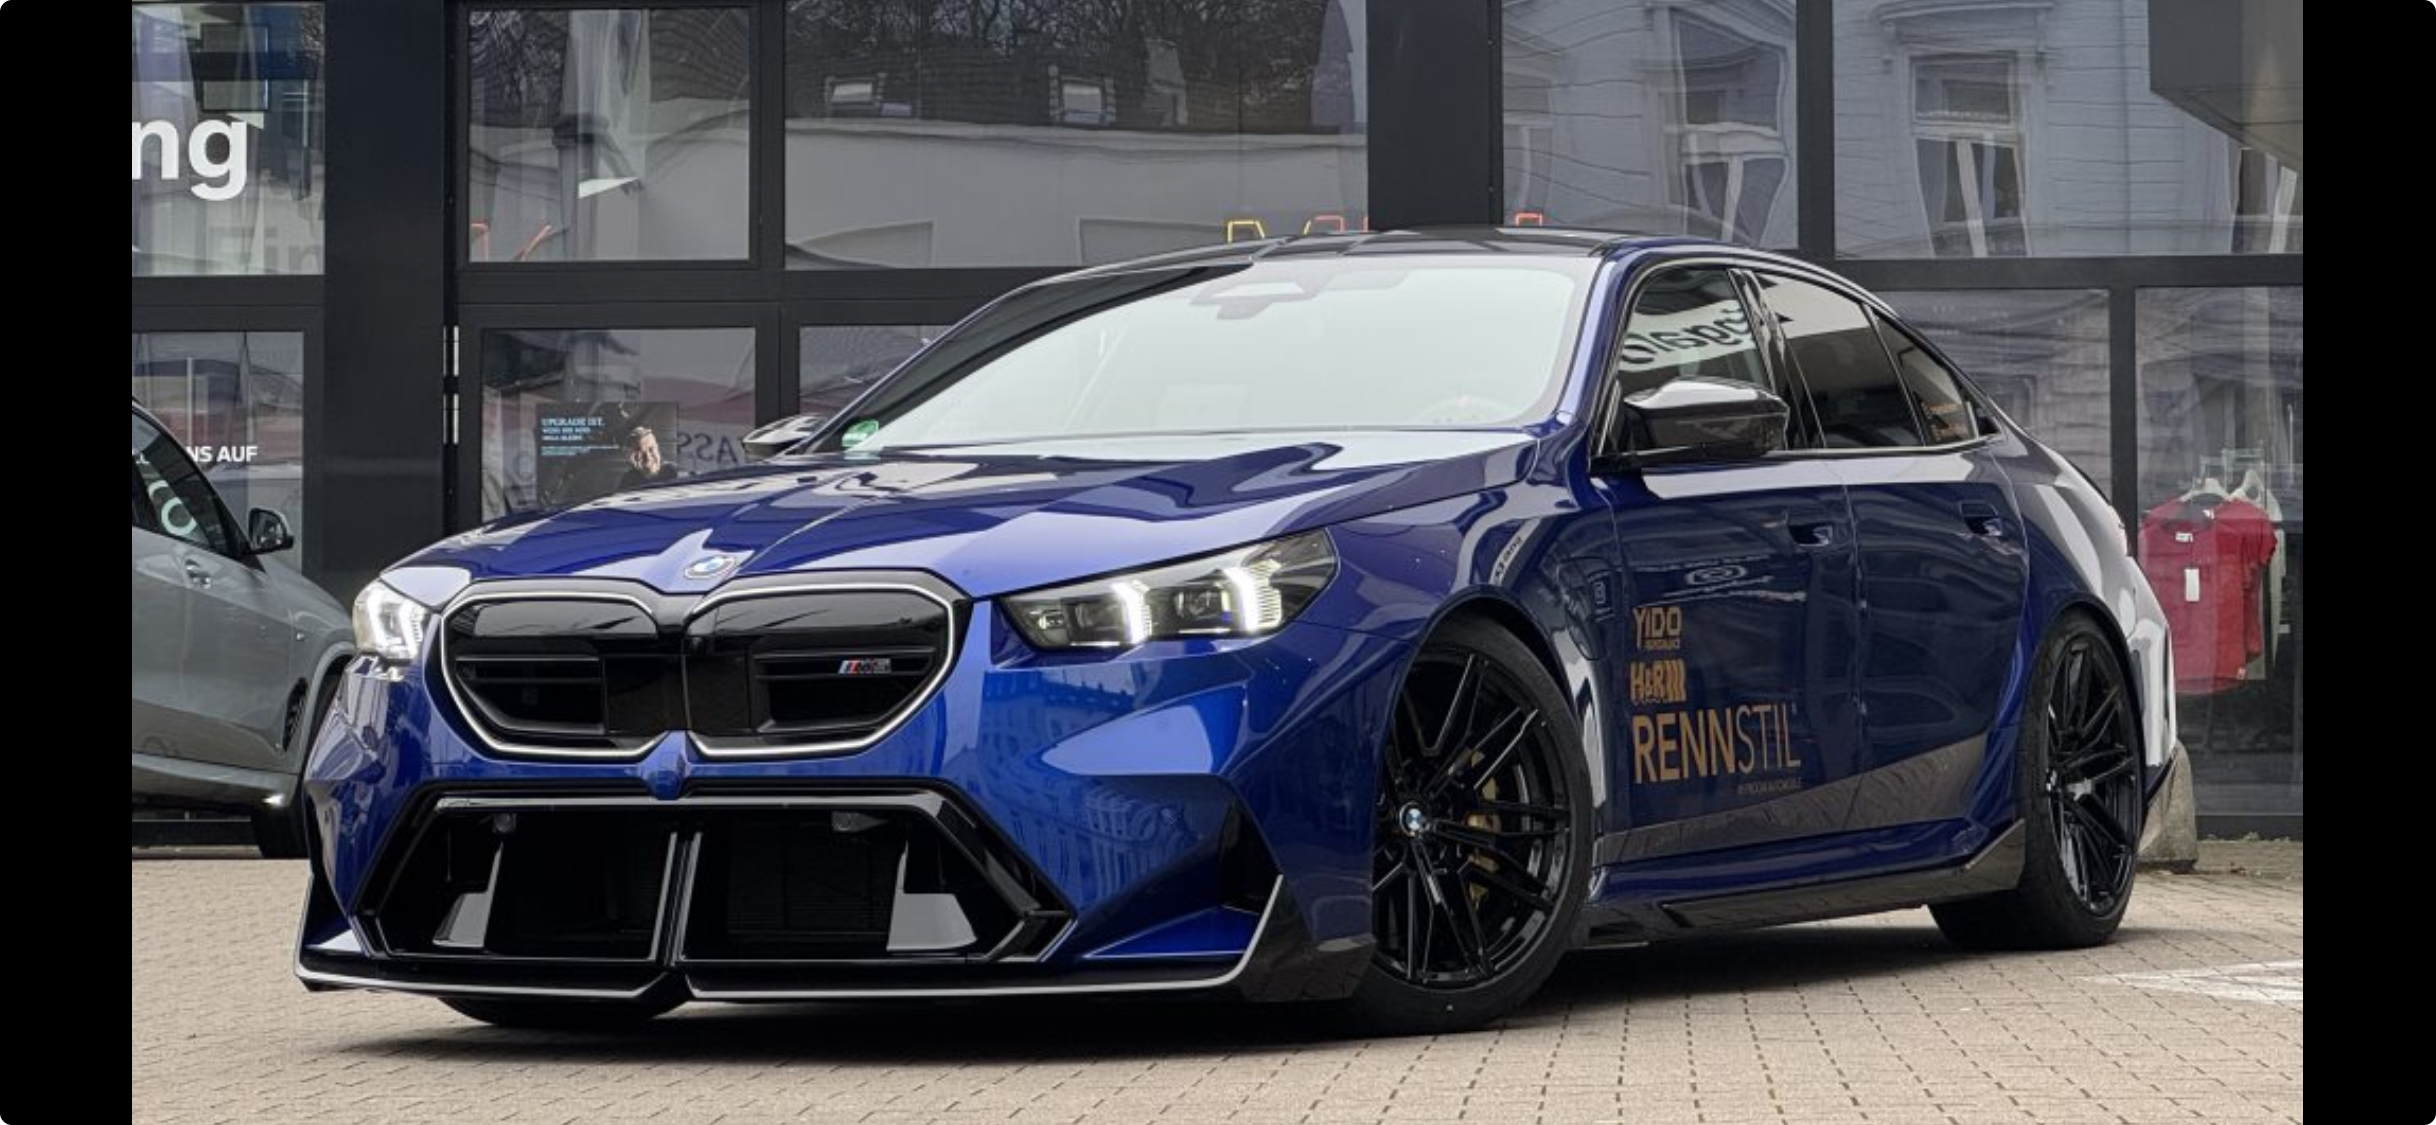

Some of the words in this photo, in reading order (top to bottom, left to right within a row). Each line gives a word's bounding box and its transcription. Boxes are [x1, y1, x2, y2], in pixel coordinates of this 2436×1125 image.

[132, 119, 247, 202] ng
[216, 446, 259, 462] AUF
[1632, 606, 1682, 649] YIDO
[1632, 703, 1801, 784] RENNSTIL
